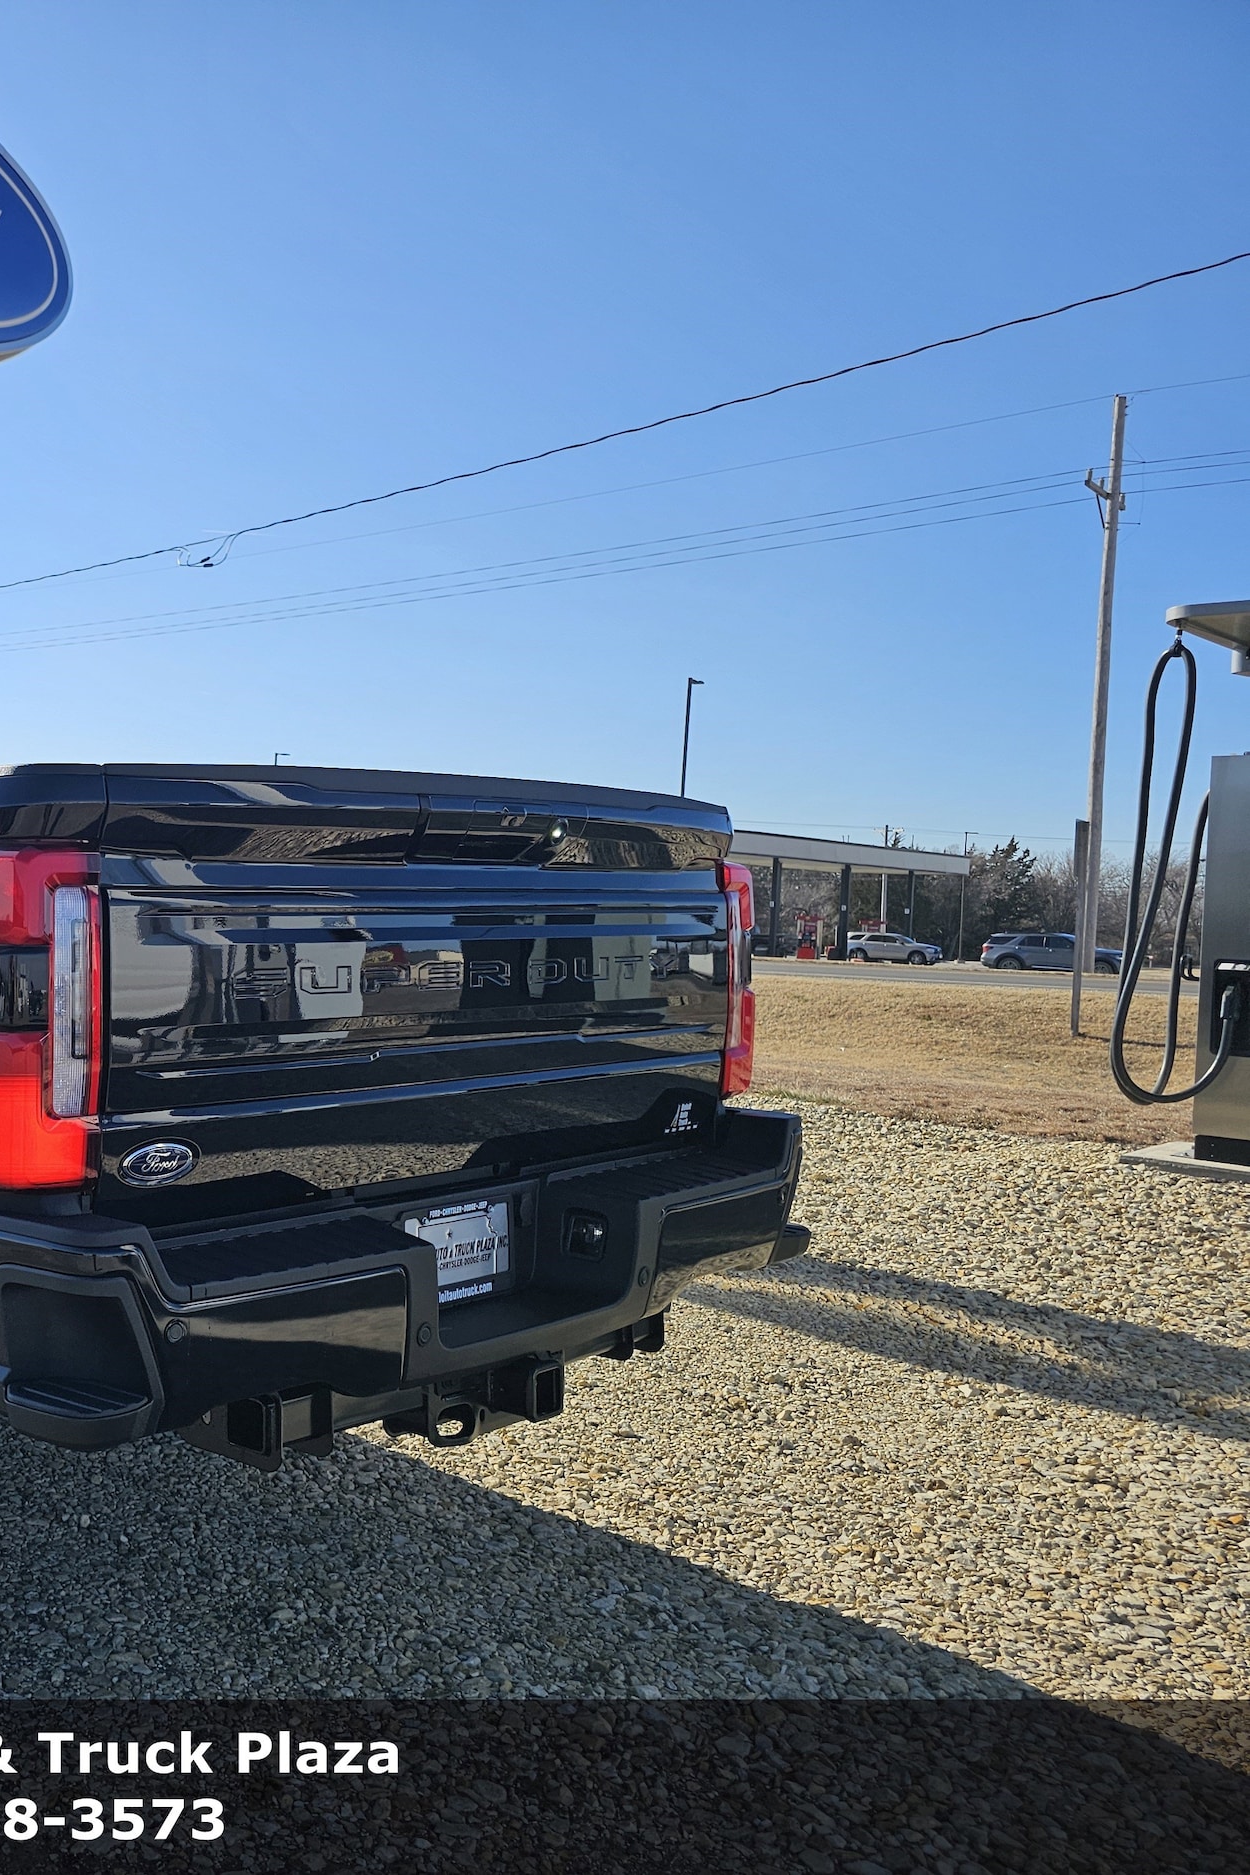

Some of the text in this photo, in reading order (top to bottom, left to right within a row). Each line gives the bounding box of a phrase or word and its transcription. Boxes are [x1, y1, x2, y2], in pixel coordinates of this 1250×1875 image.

[226, 953, 677, 1000] SUPER DUTY
[141, 1151, 180, 1172] Ford
[435, 1246, 448, 1260] UTO
[453, 1241, 475, 1258] TRUCK
[476, 1237, 495, 1253] PLAZA
[438, 1281, 493, 1304] loitautotruck.com
